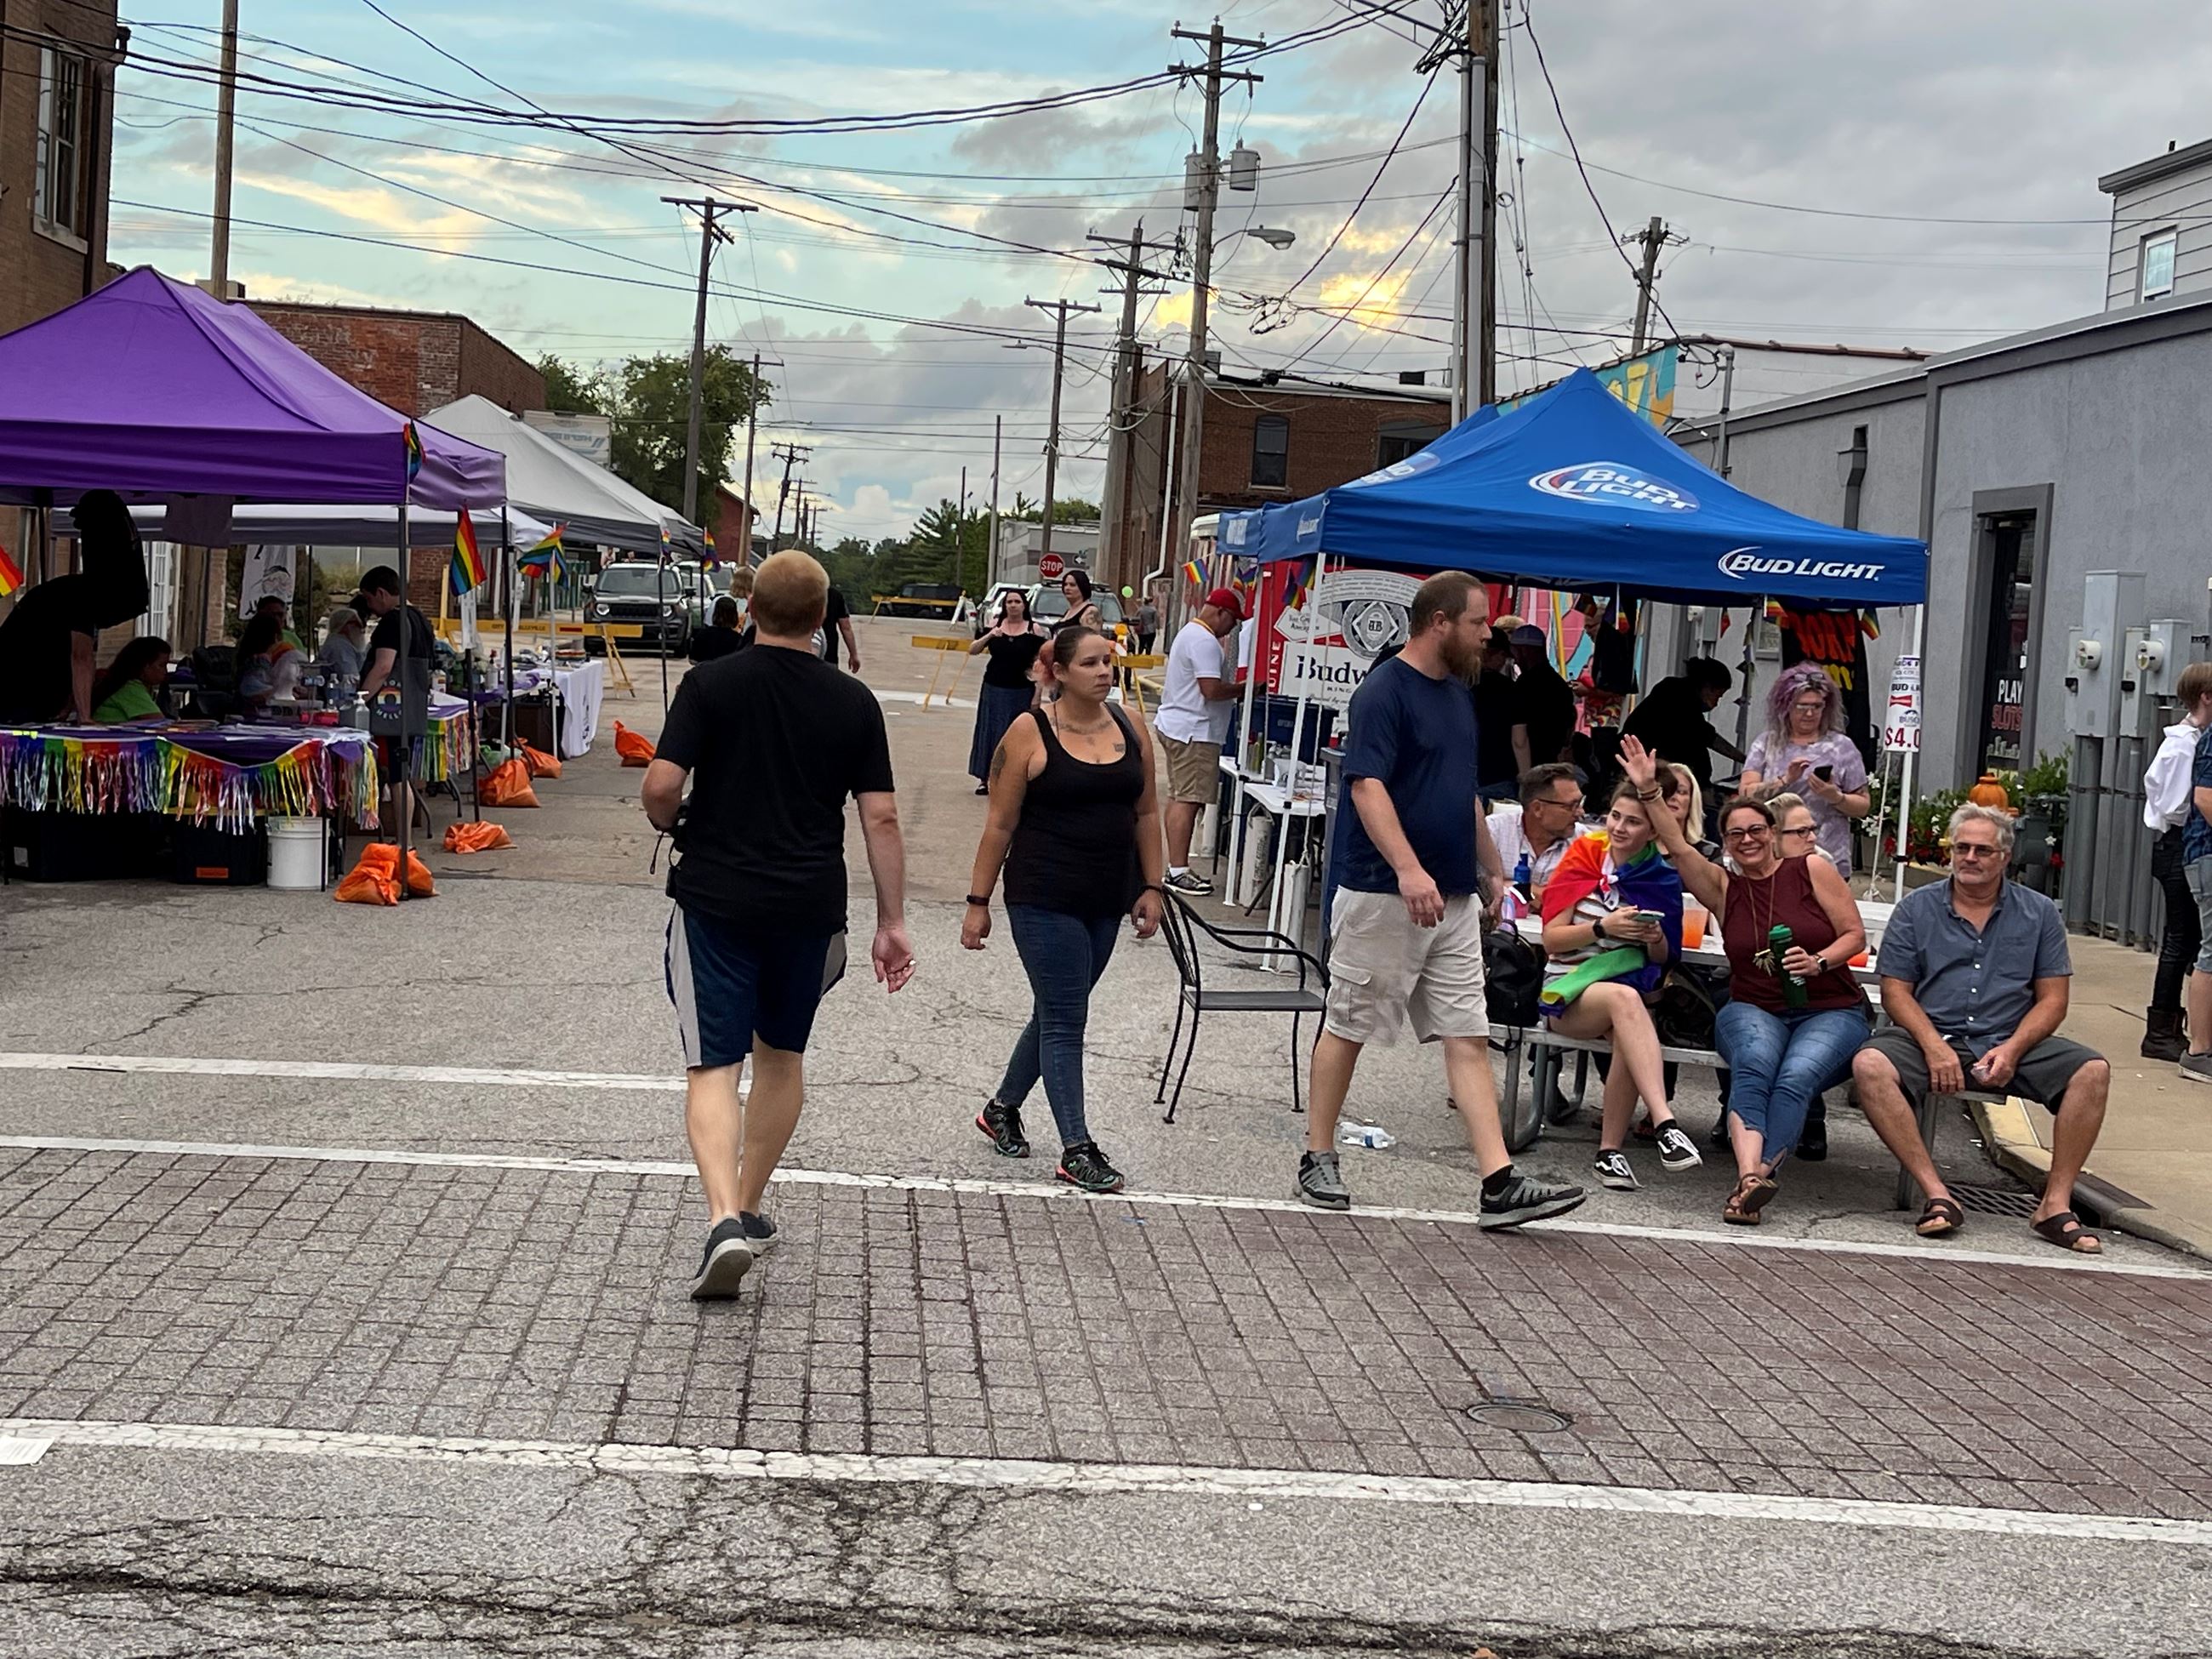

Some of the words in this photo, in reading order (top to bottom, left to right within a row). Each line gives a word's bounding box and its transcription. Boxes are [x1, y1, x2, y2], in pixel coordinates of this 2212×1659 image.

[1559, 480, 1697, 510] LIGHT
[1579, 469, 1679, 499] BUD
[1040, 561, 1063, 572] STOP
[1729, 554, 1795, 574] BUD
[1794, 558, 1885, 580] LIGHT
[1998, 679, 2023, 704] PLAY
[1992, 704, 2022, 732] SLOTS
